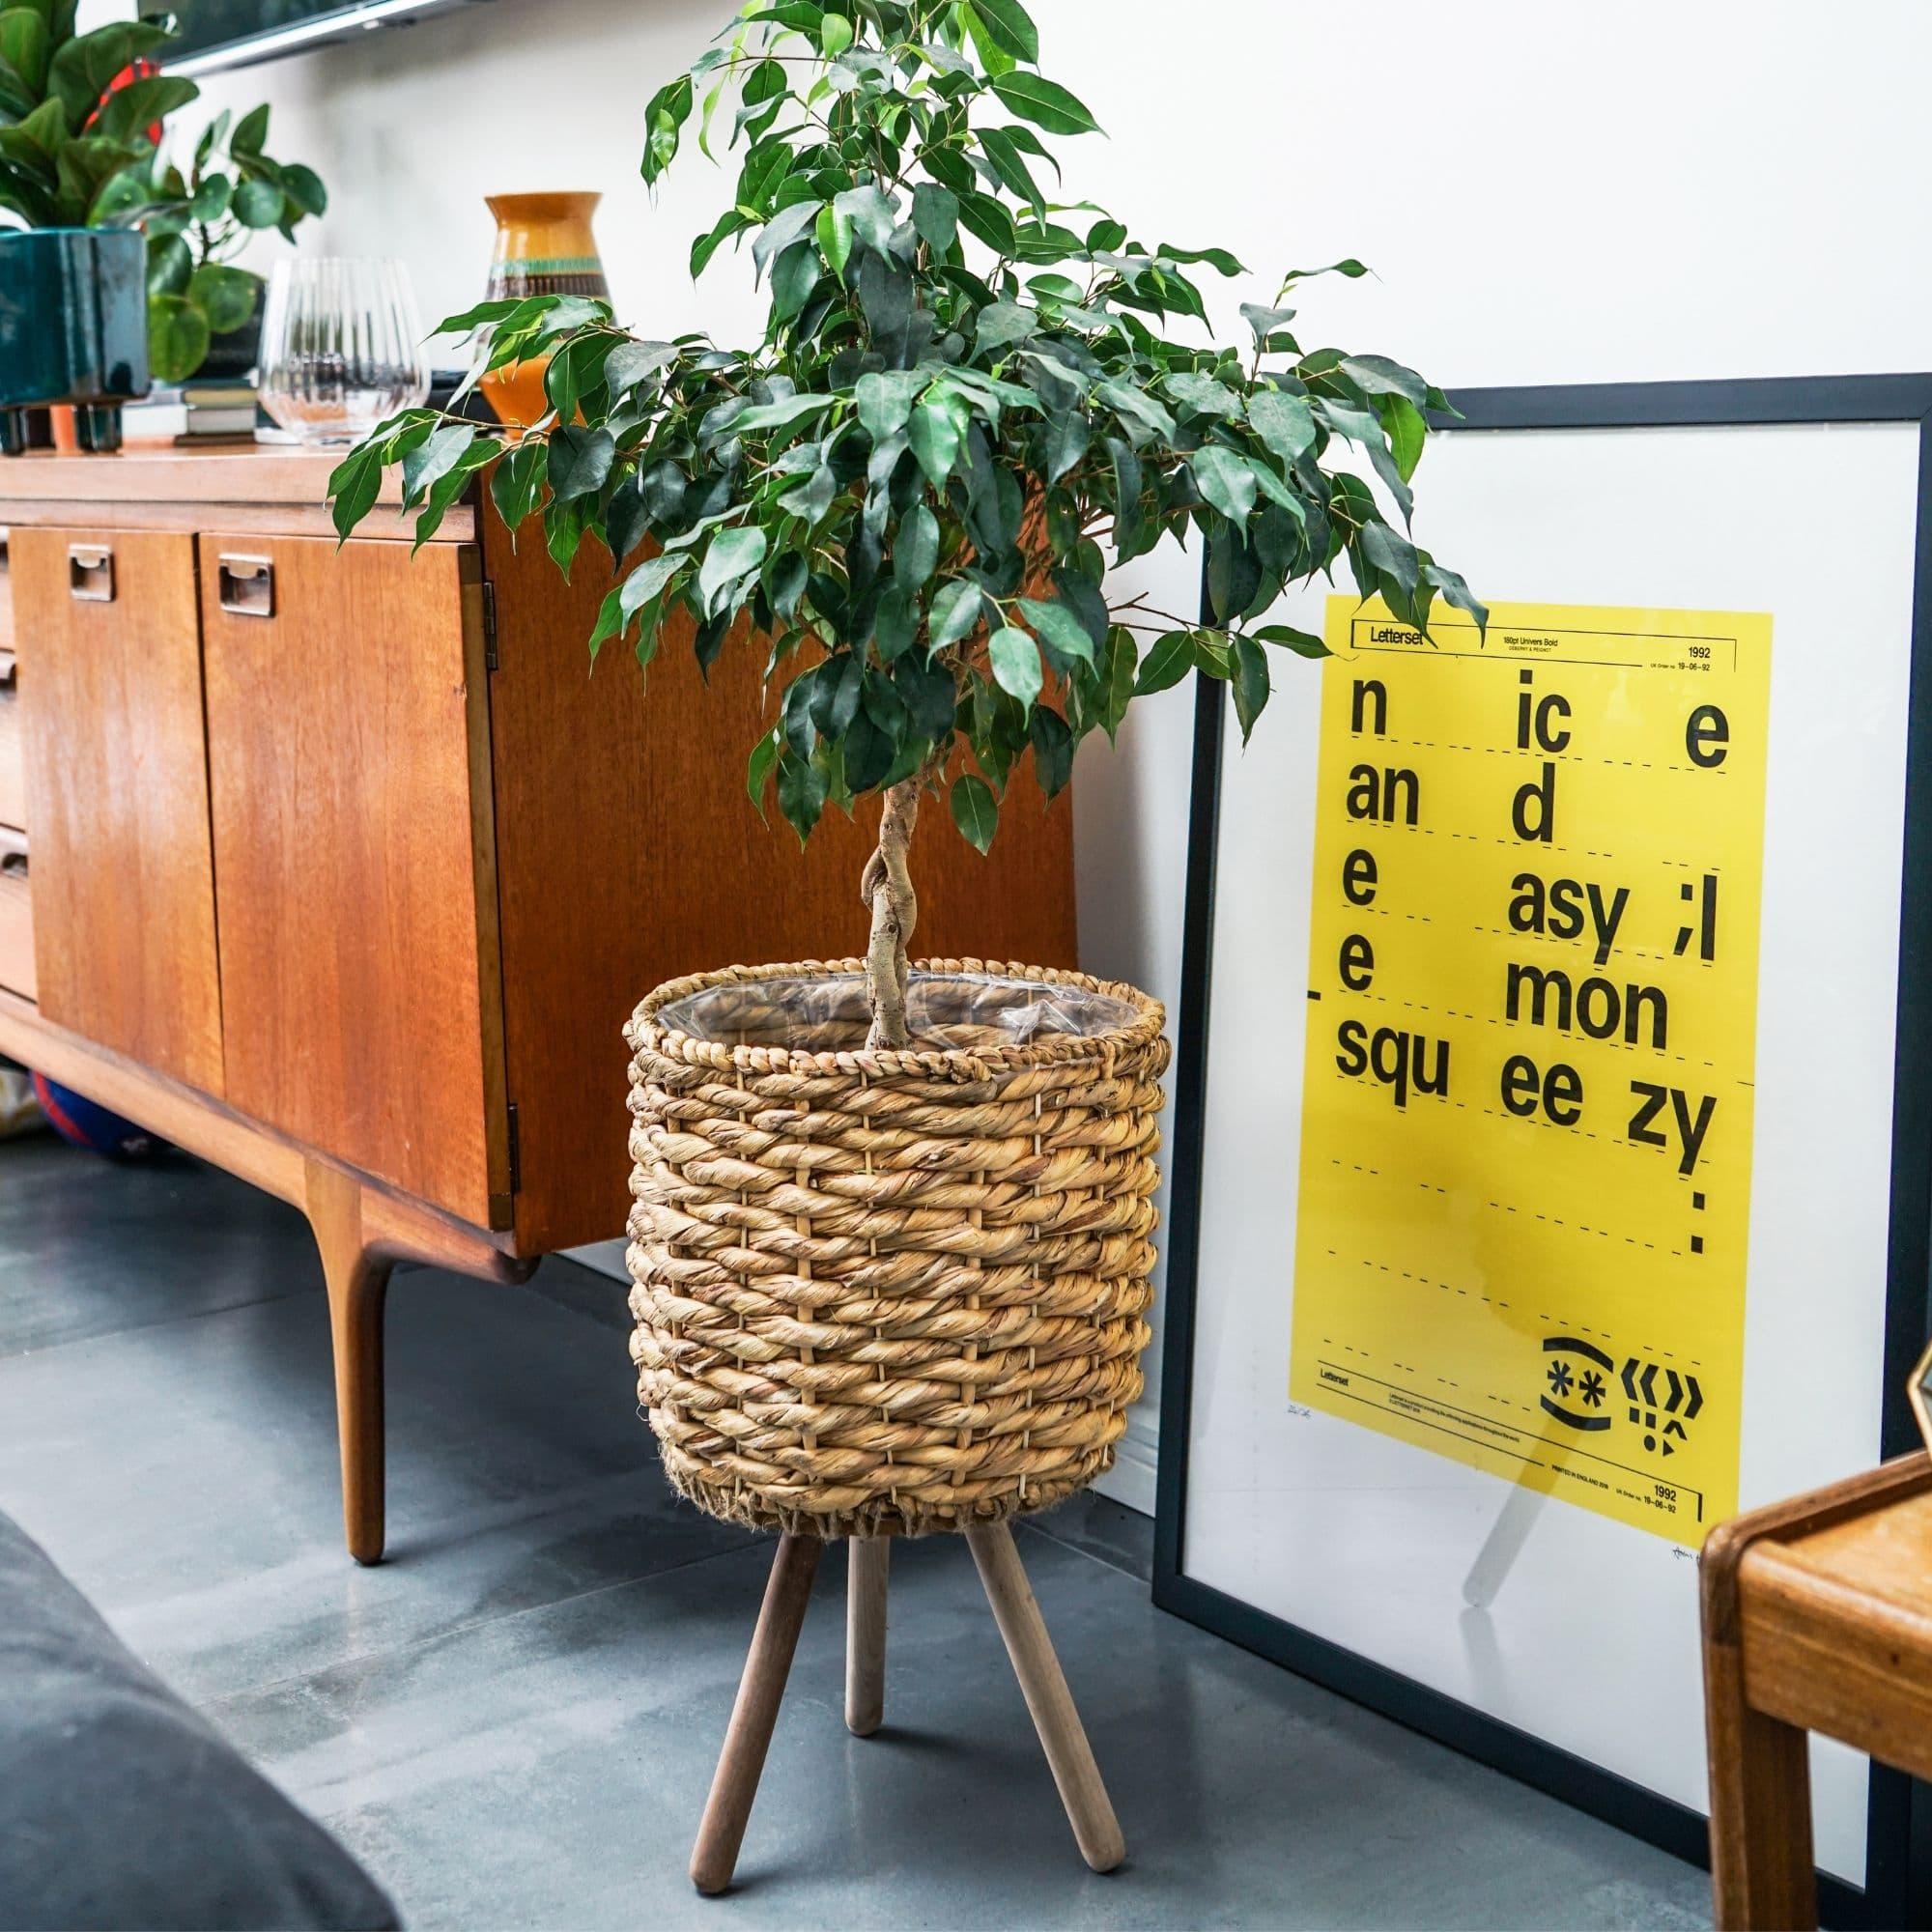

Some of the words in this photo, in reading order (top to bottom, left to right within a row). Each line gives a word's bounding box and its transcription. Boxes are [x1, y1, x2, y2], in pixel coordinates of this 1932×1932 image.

[1370, 626, 1423, 645] Letterset
[1520, 637, 1543, 646] Univers
[1544, 638, 1559, 647] Bold
[1689, 646, 1711, 659] 1992
[1351, 679, 1387, 736] n
[1517, 668, 1572, 753] ic
[1686, 704, 1730, 768] e
[1347, 763, 1419, 826] an
[1512, 761, 1555, 843] d
[1343, 848, 1378, 906] e
[1508, 872, 1631, 966] asy
[1339, 933, 1375, 992] e
[1505, 962, 1668, 1051] mon
[1335, 1019, 1450, 1108] squ
[1500, 1055, 1583, 1126] ee
[1628, 1080, 1718, 1177] zy
[1643, 1495, 1676, 1514] 19-06-92
[1654, 1485, 1677, 1502] 1992
